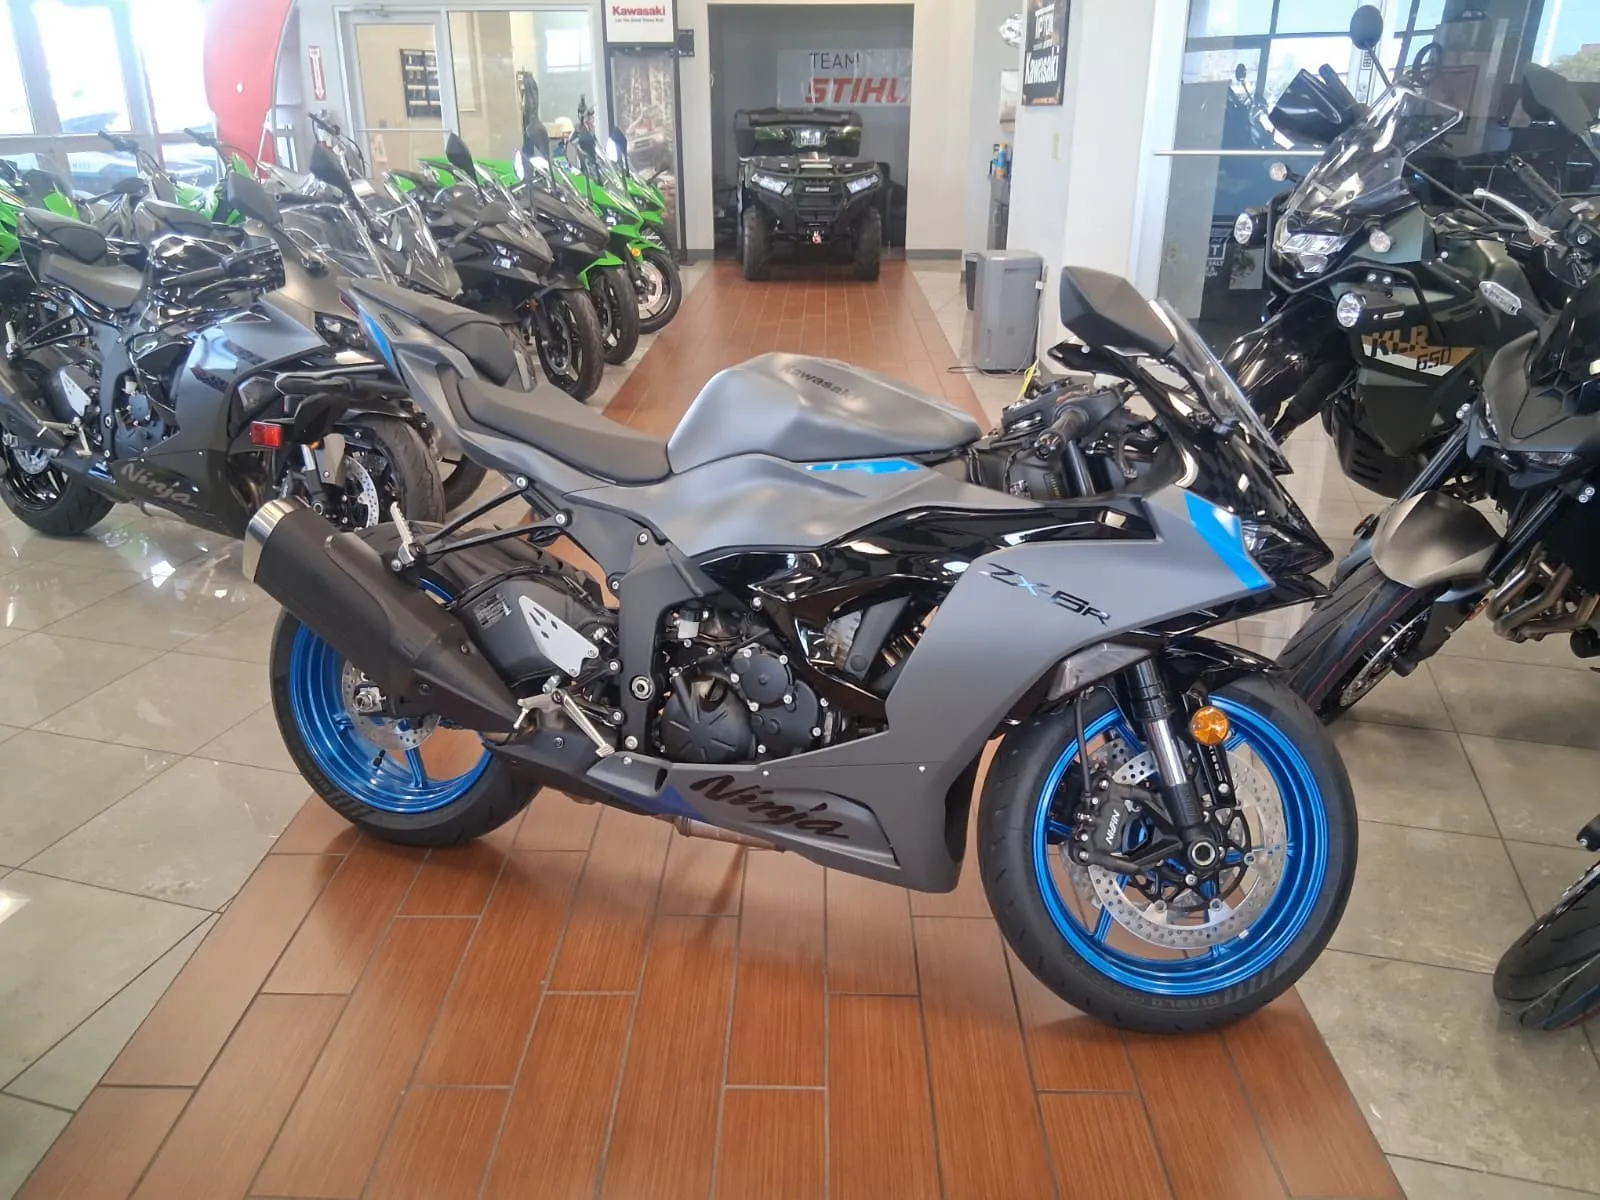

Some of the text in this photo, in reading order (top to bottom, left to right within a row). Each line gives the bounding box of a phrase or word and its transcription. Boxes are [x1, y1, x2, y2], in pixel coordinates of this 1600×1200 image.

[612, 5, 666, 16] Kawasaki
[808, 52, 860, 69] TEAM
[804, 77, 908, 104] STIHL
[1370, 325, 1430, 358] KLR
[1416, 346, 1452, 371] 650
[782, 362, 853, 399] Kawasak
[121, 462, 199, 508] Ninja
[689, 774, 850, 839] Ninja
